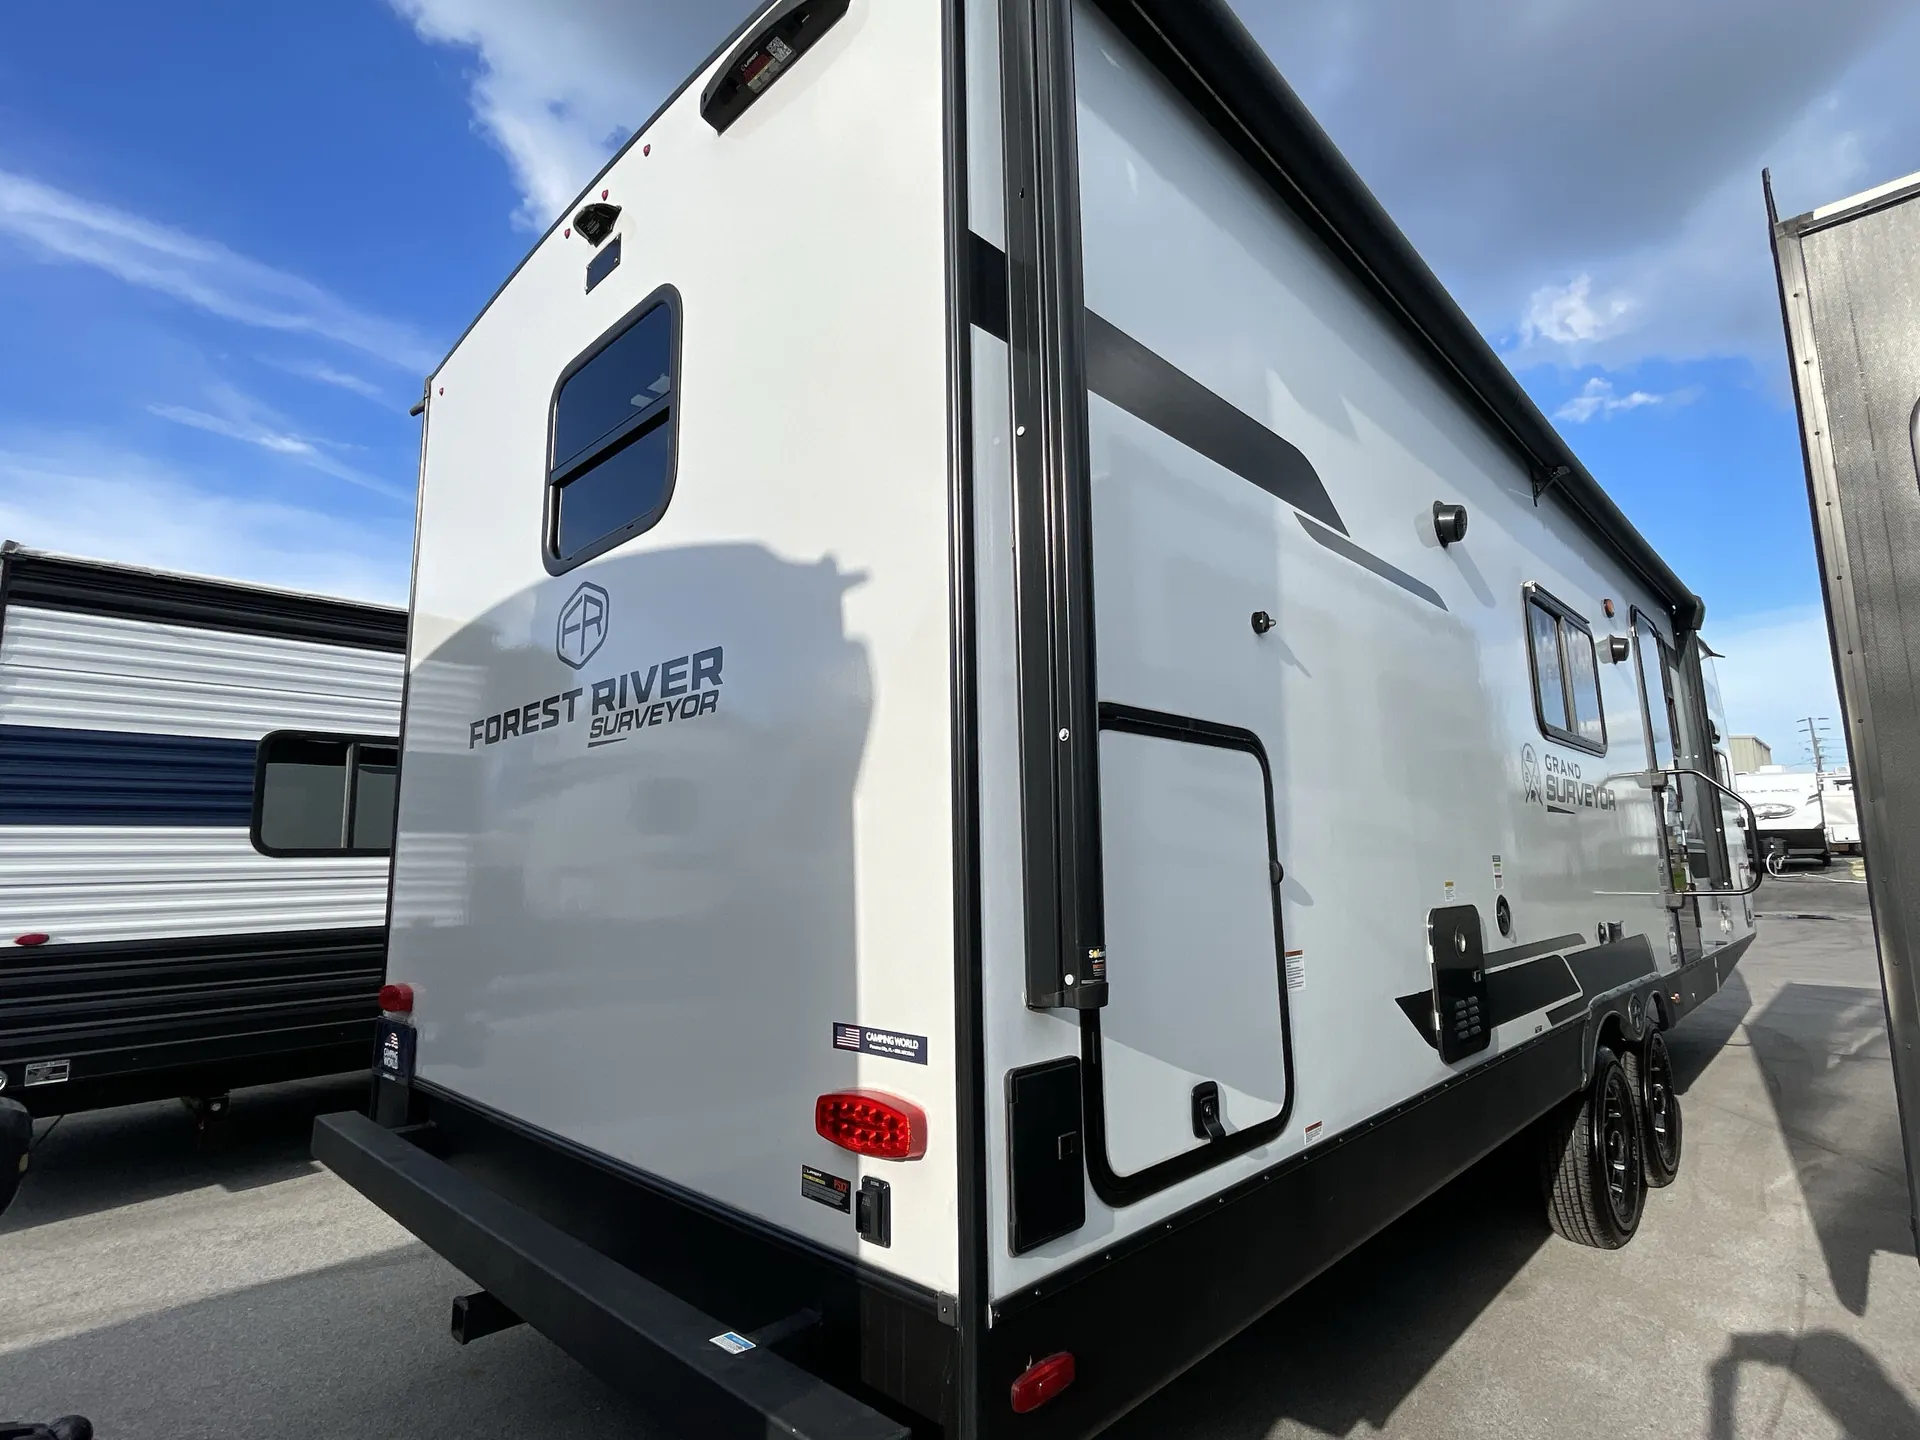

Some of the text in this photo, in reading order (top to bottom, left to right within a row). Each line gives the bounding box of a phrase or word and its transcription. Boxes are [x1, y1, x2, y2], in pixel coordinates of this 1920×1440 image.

[469, 646, 723, 749] FOREST RIVER
[589, 689, 719, 739] SURVEYOR
[1545, 754, 1581, 779] GRAND
[1546, 774, 1616, 811] SURVEYOR
[866, 1031, 919, 1050] CAMPING WORLD
